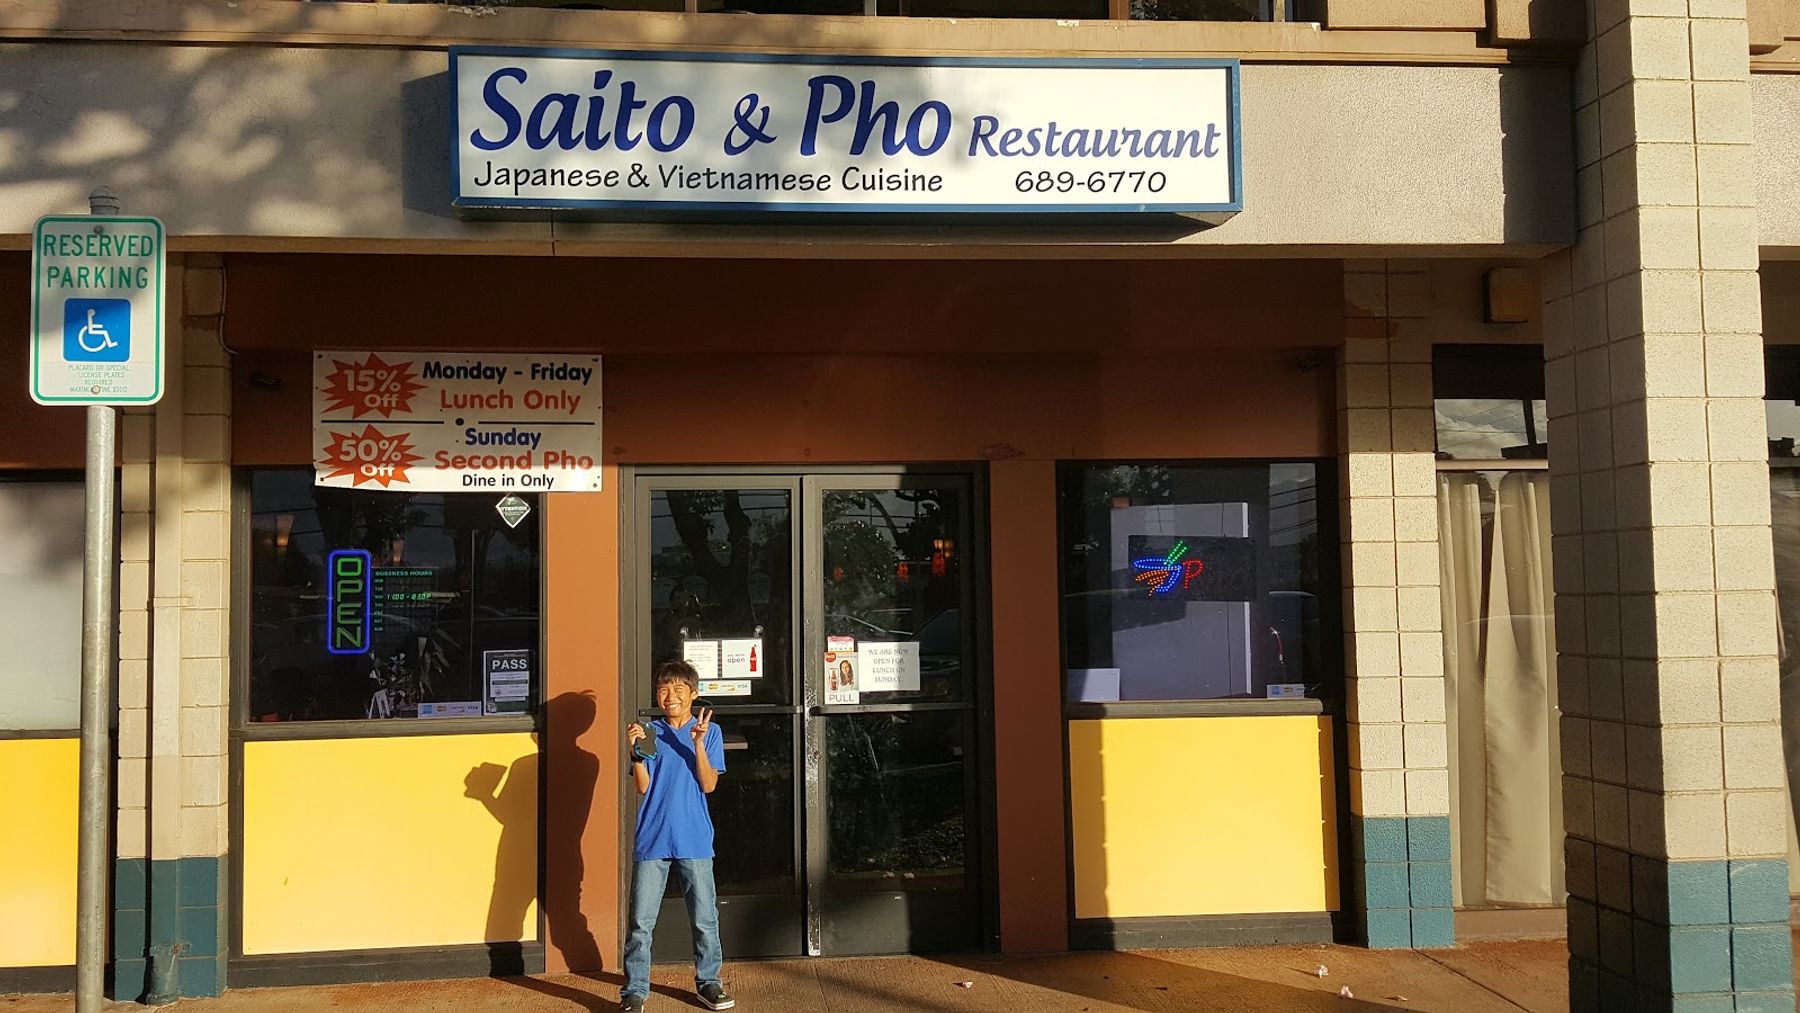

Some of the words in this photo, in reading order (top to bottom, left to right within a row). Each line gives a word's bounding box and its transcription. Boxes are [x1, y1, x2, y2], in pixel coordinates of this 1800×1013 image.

[470, 67, 695, 153] Saito
[723, 93, 777, 156] &
[799, 75, 952, 157] Pho
[968, 115, 1222, 158] Restaurant
[474, 160, 619, 196] Japanese
[627, 163, 650, 188] &
[658, 164, 831, 192] Vietnamese
[841, 167, 943, 192] Cuisine
[1015, 170, 1167, 194] 689-6770
[43, 234, 154, 257] RESERVED
[47, 266, 148, 289] PARKING
[345, 369, 400, 393] 15%
[422, 362, 507, 384] Monday
[531, 362, 593, 385] Friday
[363, 393, 400, 409] Off
[440, 390, 514, 410] Lunch
[523, 390, 581, 415] Only
[465, 427, 541, 450] Sunday
[339, 439, 402, 462] 50%
[434, 450, 533, 471] Second
[544, 450, 594, 470] Pho
[360, 462, 395, 477] Off
[462, 474, 496, 487] Dine
[502, 474, 515, 487] in
[520, 474, 554, 489] Only
[336, 557, 363, 649] OPEN
[492, 658, 527, 670] PASS
[873, 657, 891, 665] OPEN
[892, 657, 905, 665] FOR
[828, 693, 855, 702] PULL
